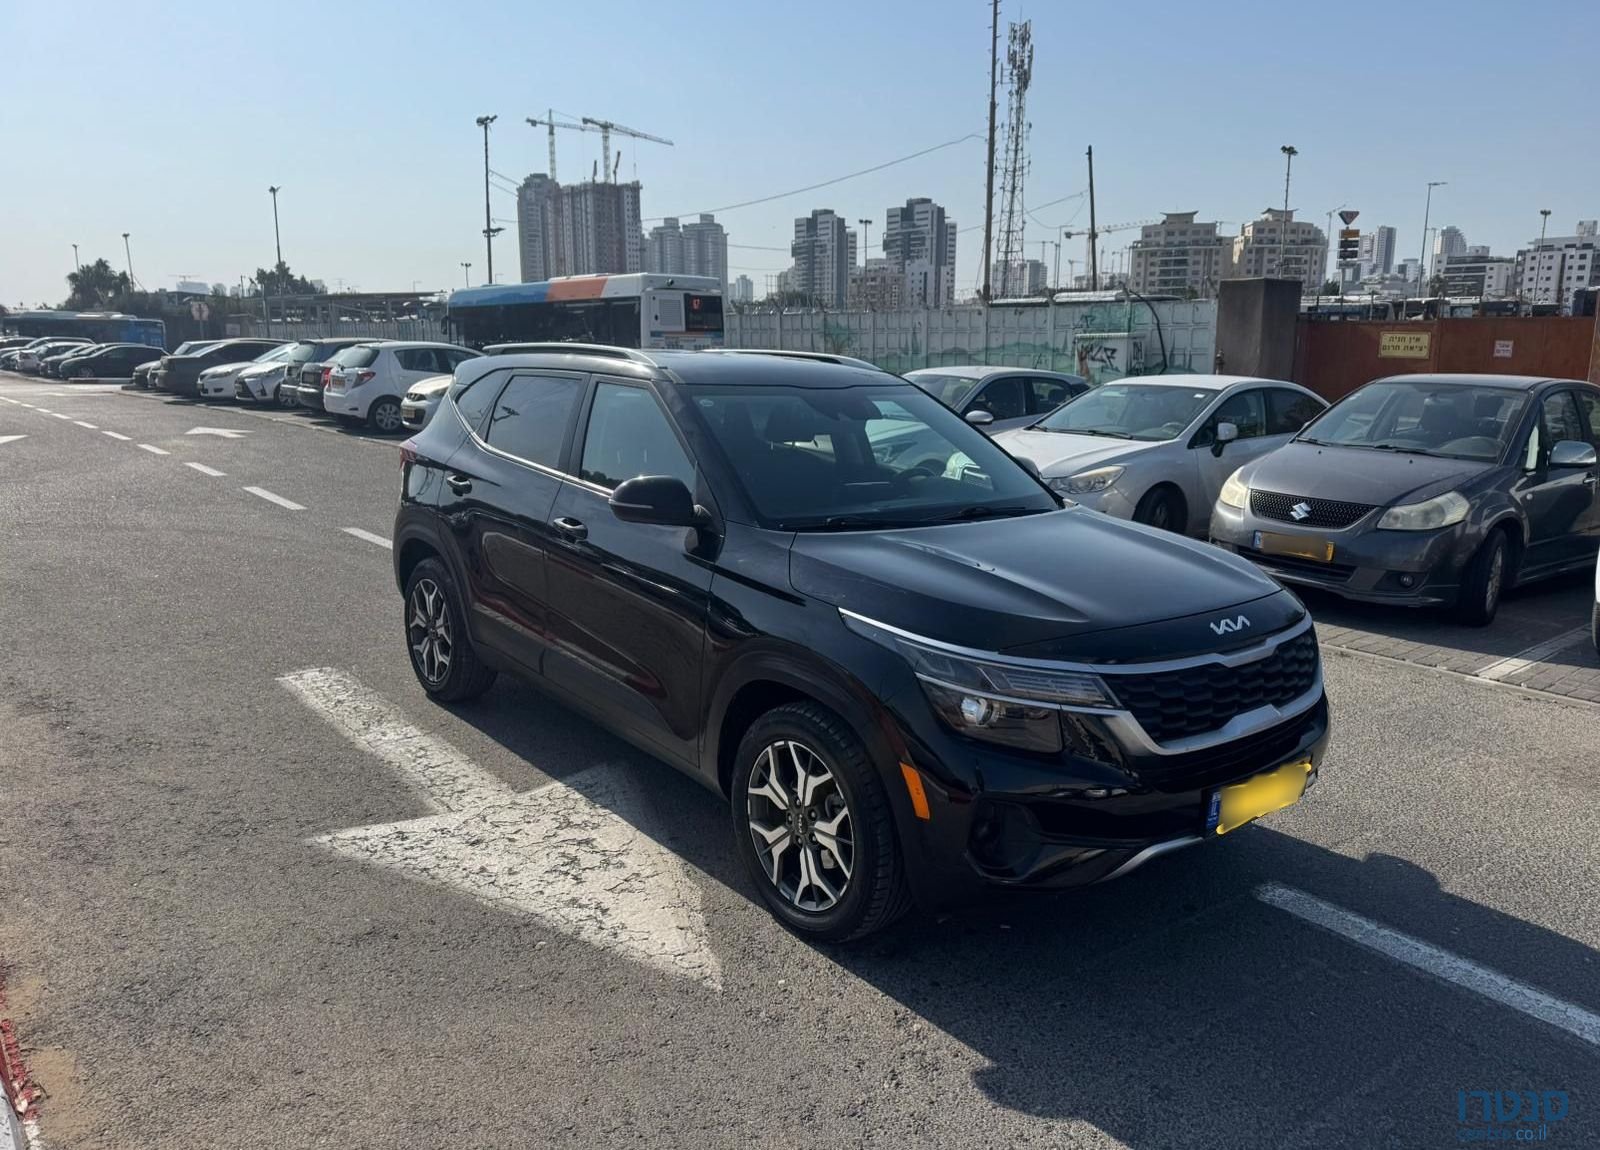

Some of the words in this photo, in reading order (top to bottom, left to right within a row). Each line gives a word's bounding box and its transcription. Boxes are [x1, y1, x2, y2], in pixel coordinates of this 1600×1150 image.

[1389, 335, 1406, 343] חניה
[1408, 335, 1421, 344] אין
[1210, 615, 1250, 635] KIA
